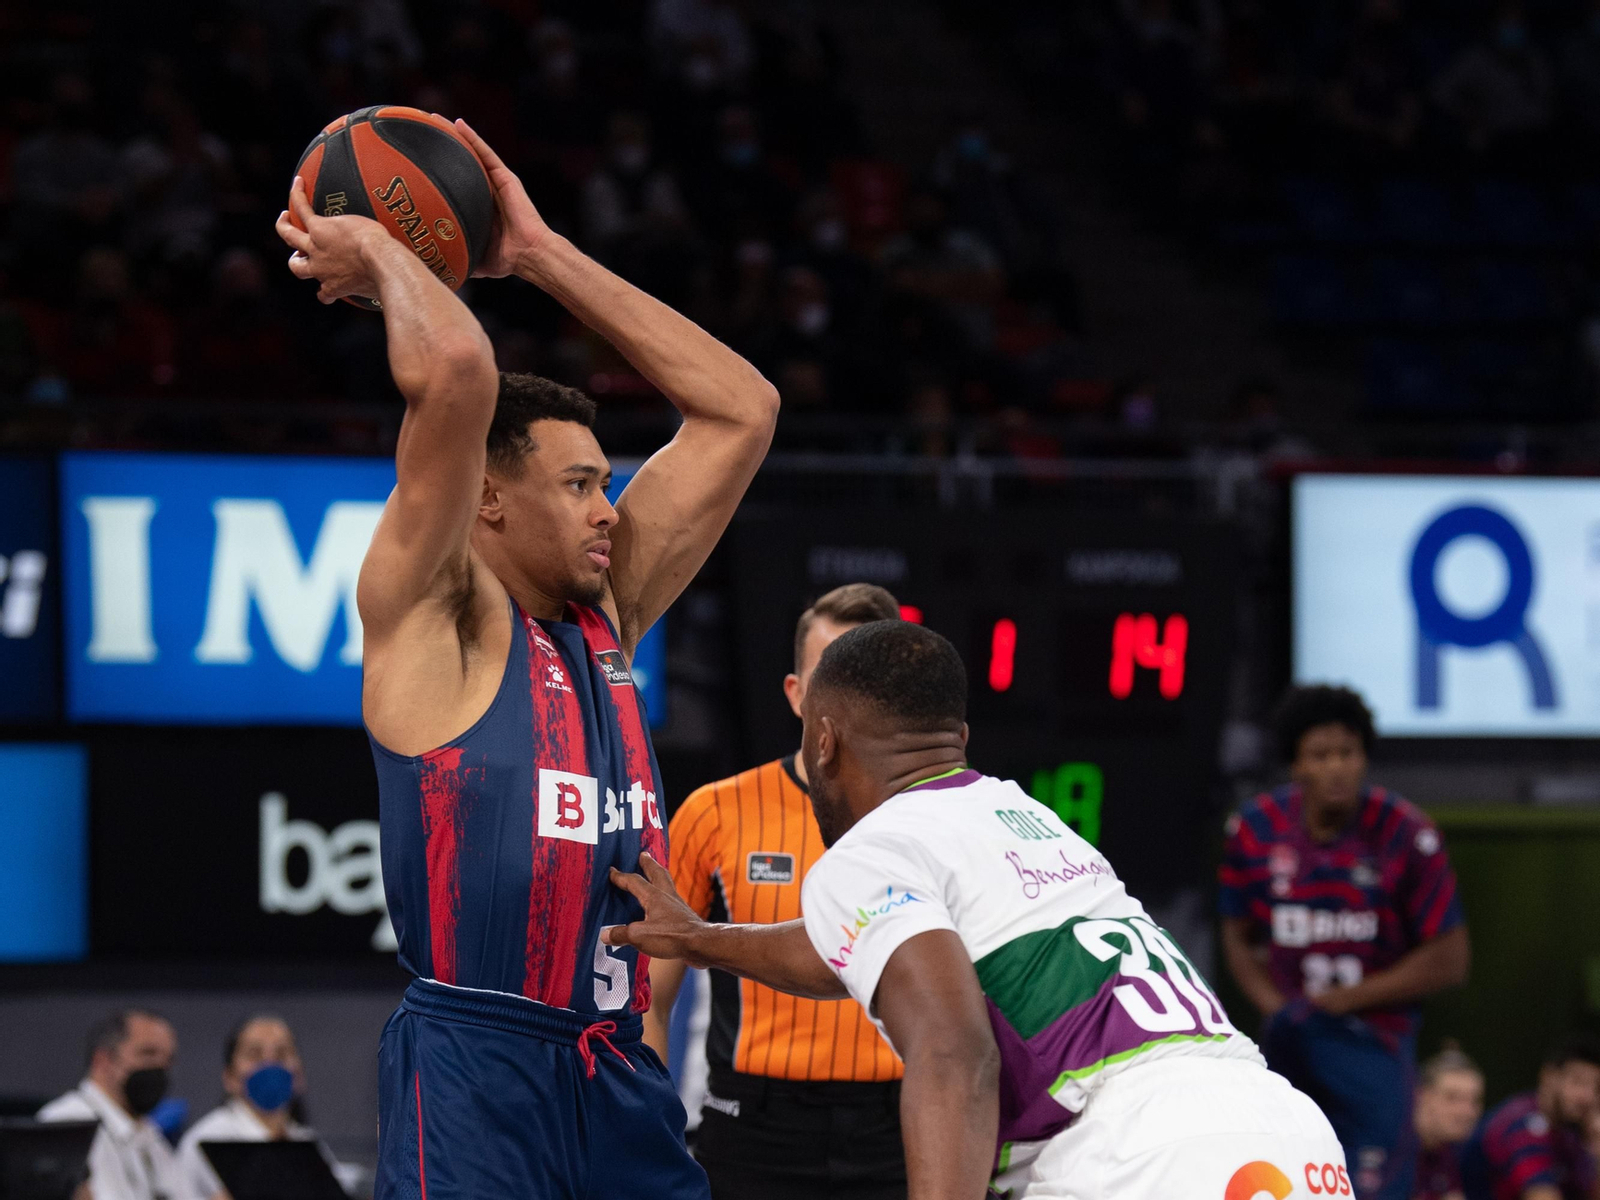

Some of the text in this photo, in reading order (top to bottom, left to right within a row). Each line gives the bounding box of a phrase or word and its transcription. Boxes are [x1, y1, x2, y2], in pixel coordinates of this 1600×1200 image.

[82, 496, 392, 673] IM
[988, 617, 1017, 693] 1
[1109, 611, 1190, 700] 14
[602, 780, 664, 834] Bitc
[995, 809, 1063, 841] COLE
[258, 791, 399, 952] ba
[593, 924, 630, 1011] 5
[1073, 916, 1235, 1036] 30
[1304, 1162, 1350, 1196] COS
